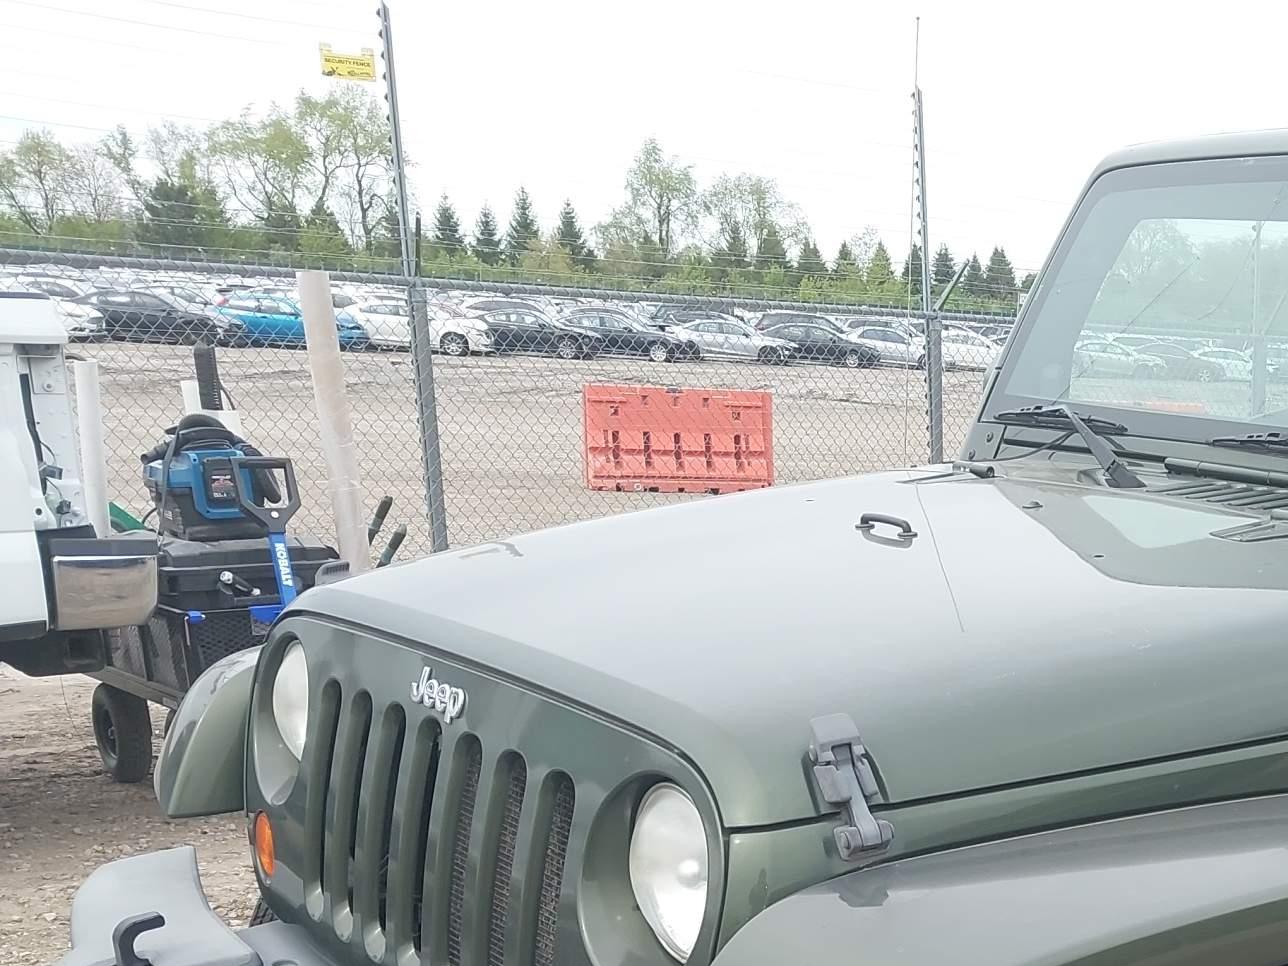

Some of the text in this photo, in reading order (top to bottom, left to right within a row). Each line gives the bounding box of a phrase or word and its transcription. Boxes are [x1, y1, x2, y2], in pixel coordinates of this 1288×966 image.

[324, 57, 351, 65] SECURITY
[274, 543, 293, 587] KOBALT
[410, 665, 465, 724] Jeep
